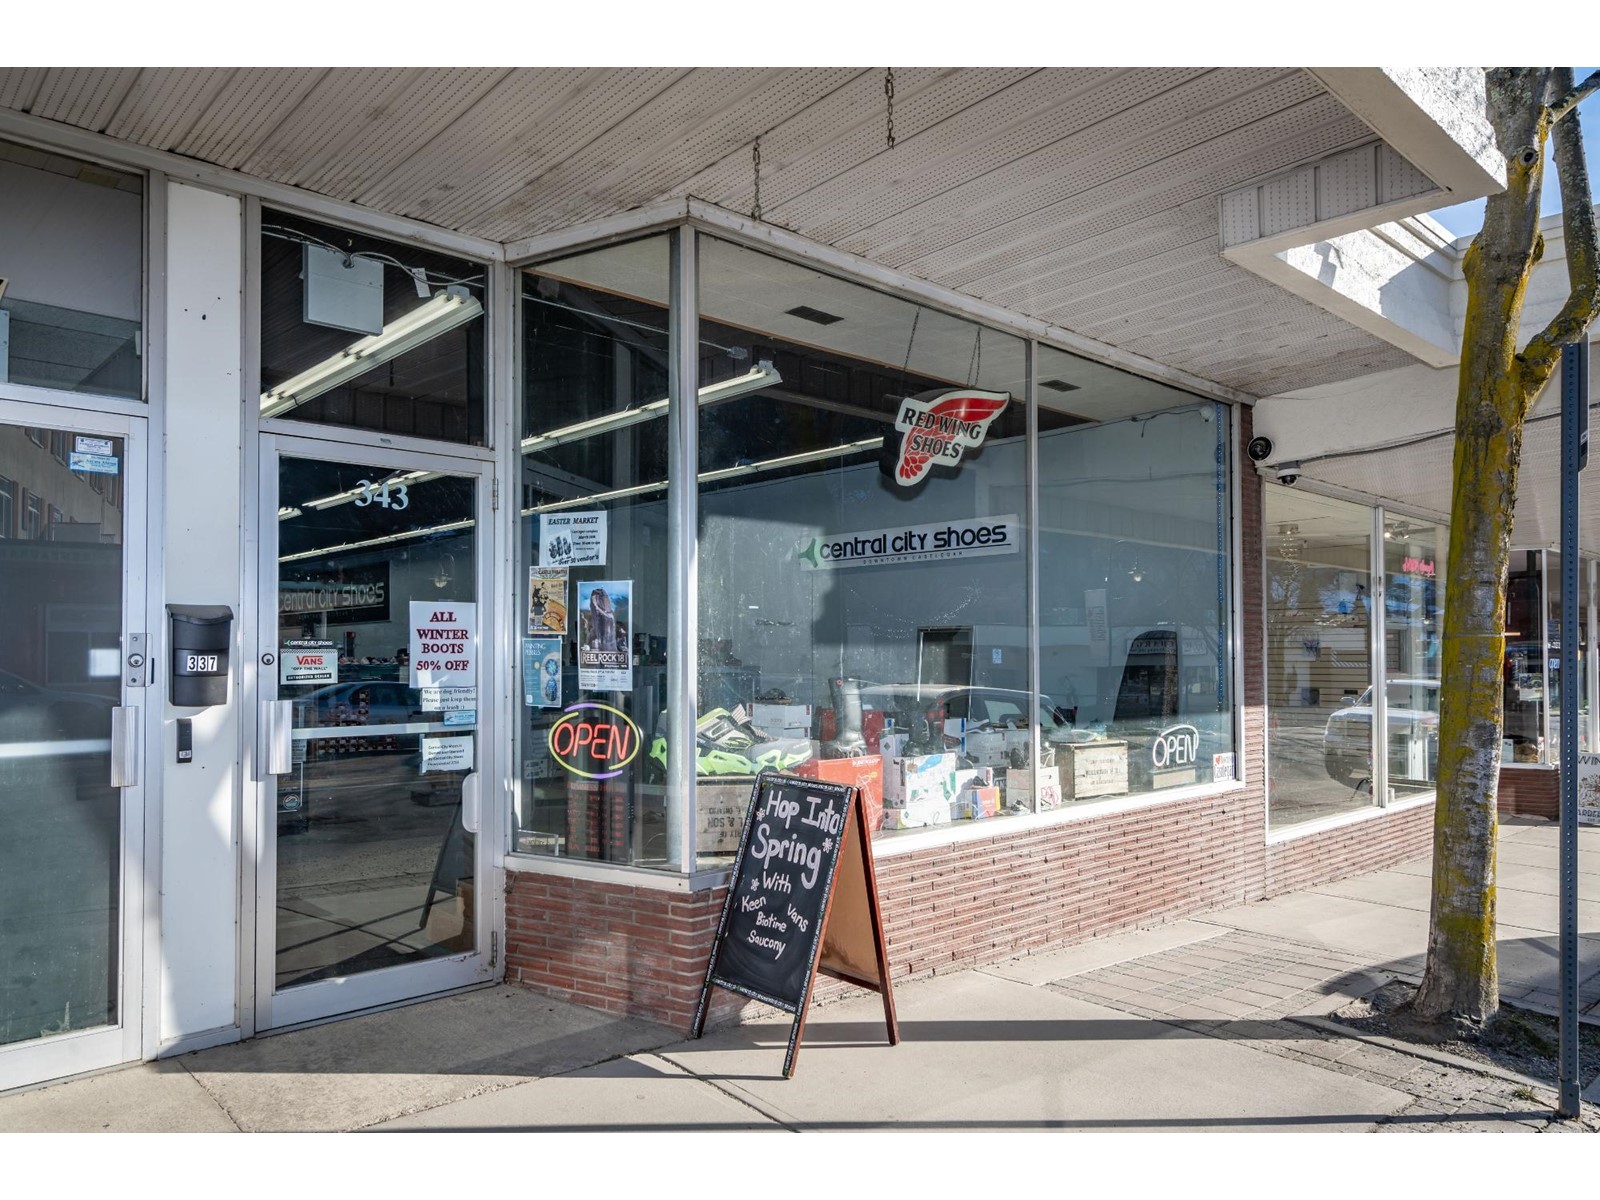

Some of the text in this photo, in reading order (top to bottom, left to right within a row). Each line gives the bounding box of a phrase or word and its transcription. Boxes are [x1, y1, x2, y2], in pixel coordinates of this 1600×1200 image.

[901, 407, 982, 440] RED WING
[910, 435, 961, 459] SHOES
[354, 478, 409, 511] 343
[573, 516, 599, 524] MARKET
[819, 525, 1007, 559] central city shoes
[863, 556, 908, 565] DOWNTOWN
[342, 582, 385, 607] shoes
[429, 611, 457, 622] ALL
[416, 628, 469, 640] WINTER
[421, 643, 464, 654] BOOTS
[582, 653, 625, 663] REEL ROCK 18
[187, 656, 216, 671] 337
[296, 655, 324, 665] VANS
[416, 660, 470, 671] 50% OFF
[553, 722, 630, 760] OPEN
[1152, 734, 1197, 767] OPEN
[708, 817, 725, 828] SON
[766, 790, 841, 835] Hop Into
[751, 824, 822, 890] Spring
[762, 871, 792, 894] With
[741, 895, 767, 912] Keen
[755, 911, 787, 932] Biotime
[787, 903, 809, 932] Vans
[748, 930, 786, 960] Saucony
